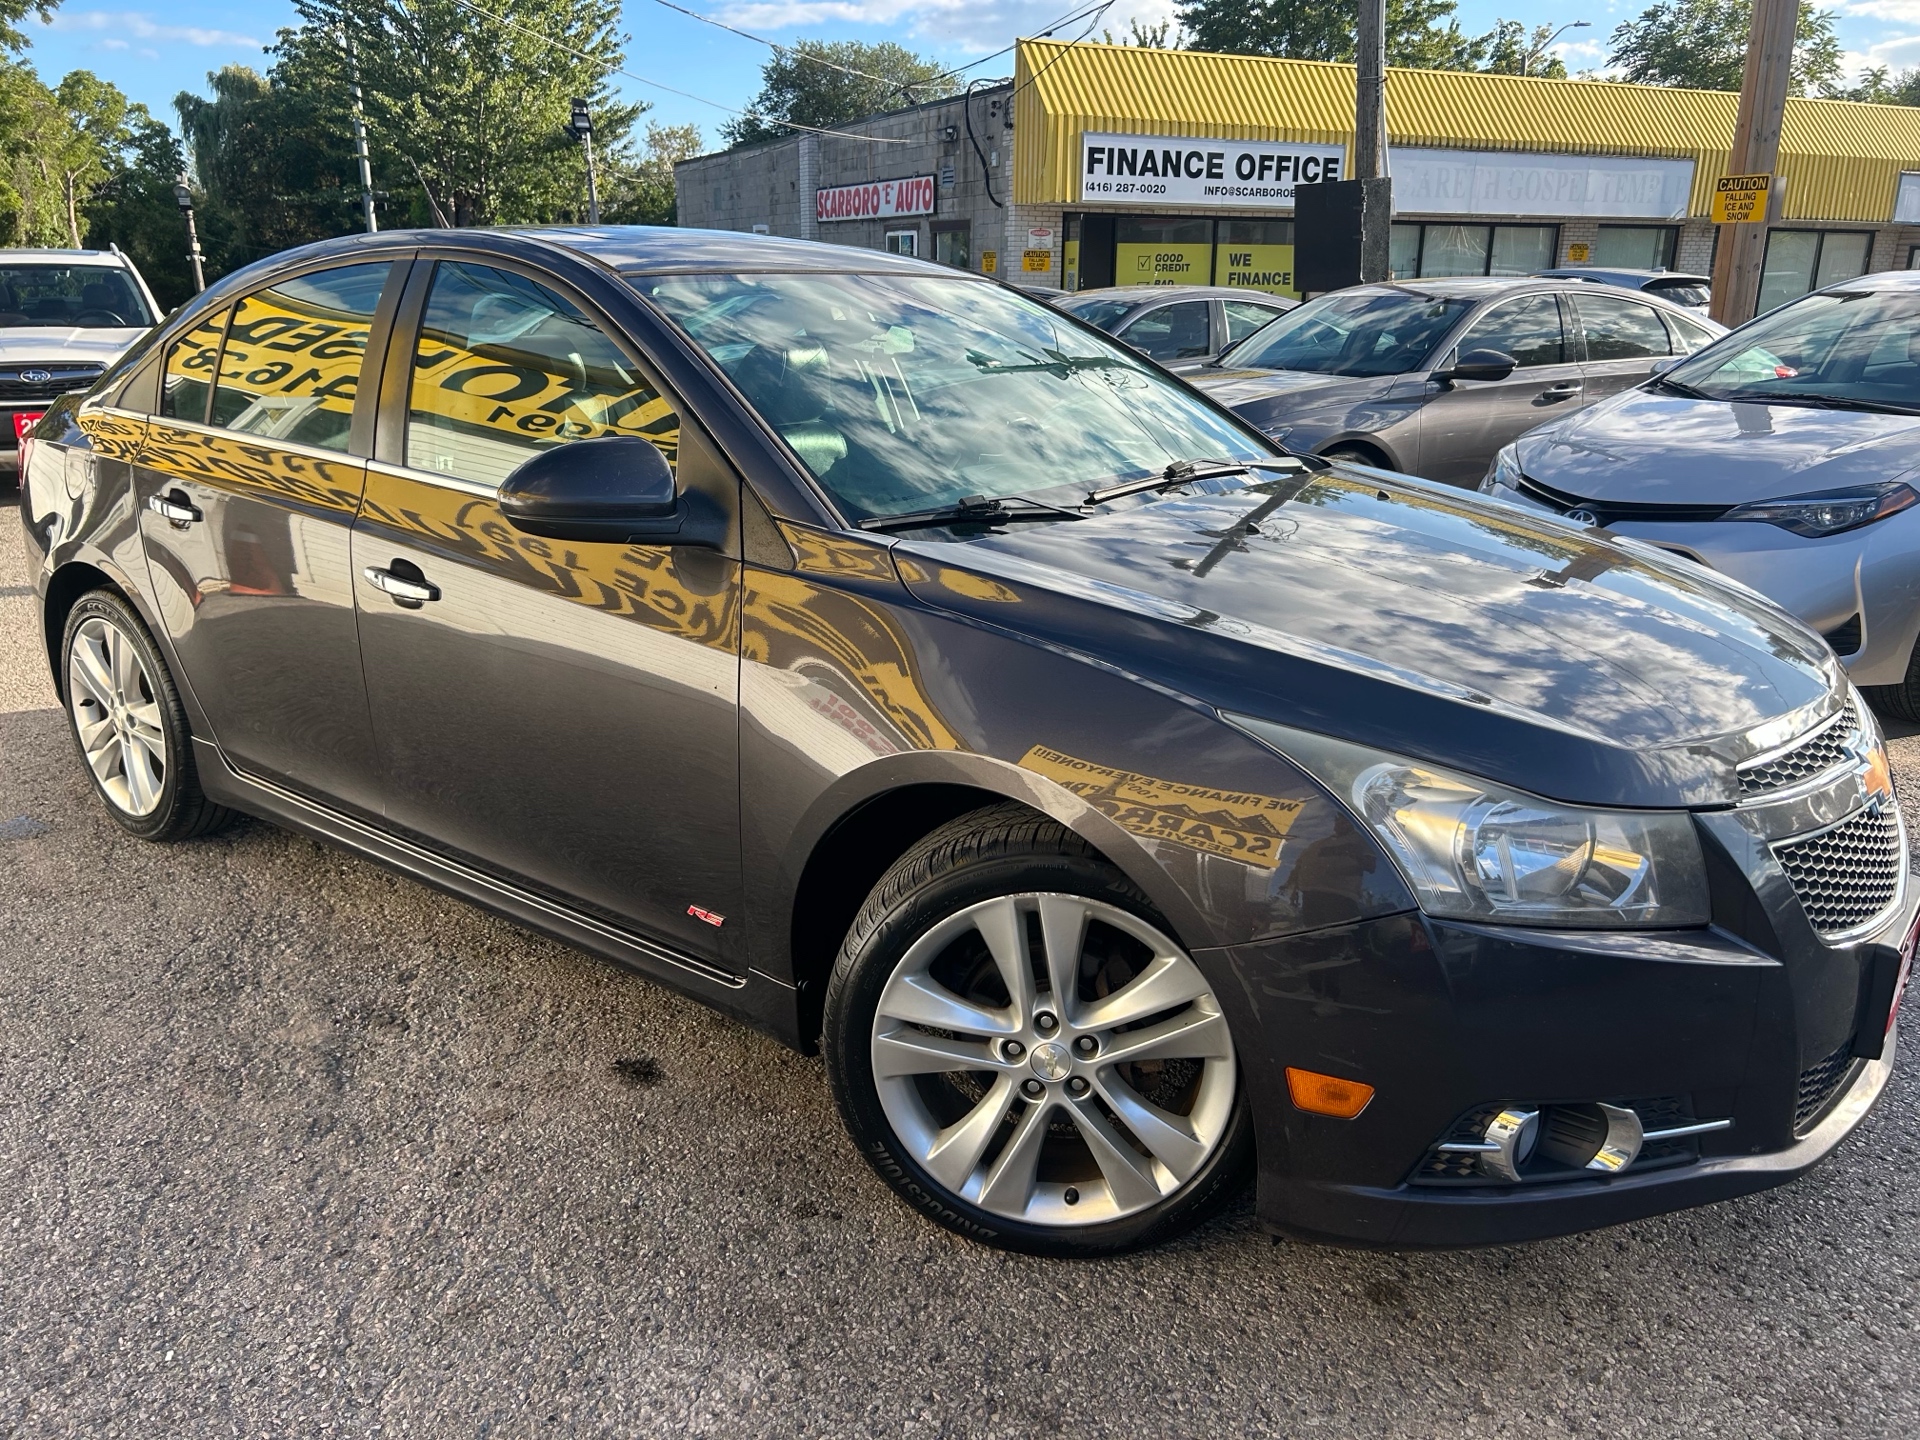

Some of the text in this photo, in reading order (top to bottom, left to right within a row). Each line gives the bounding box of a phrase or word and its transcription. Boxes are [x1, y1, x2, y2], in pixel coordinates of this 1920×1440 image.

[1087, 147, 1340, 183] FINANCE OFFICE
[1085, 181, 1167, 194] (416) 287-0020
[1507, 168, 1595, 202] GOSPEL
[1719, 177, 1768, 191] CAUTION
[817, 185, 880, 219] SCARBORO
[895, 178, 933, 213] AUTO
[1725, 192, 1757, 201] FALLING
[1724, 202, 1755, 211] ICE AND
[1726, 211, 1750, 221] SNOW
[1155, 253, 1184, 263] GOOD
[1229, 253, 1252, 267] WE
[1154, 264, 1191, 272] CREDIT
[1228, 272, 1291, 286] FINANCE
